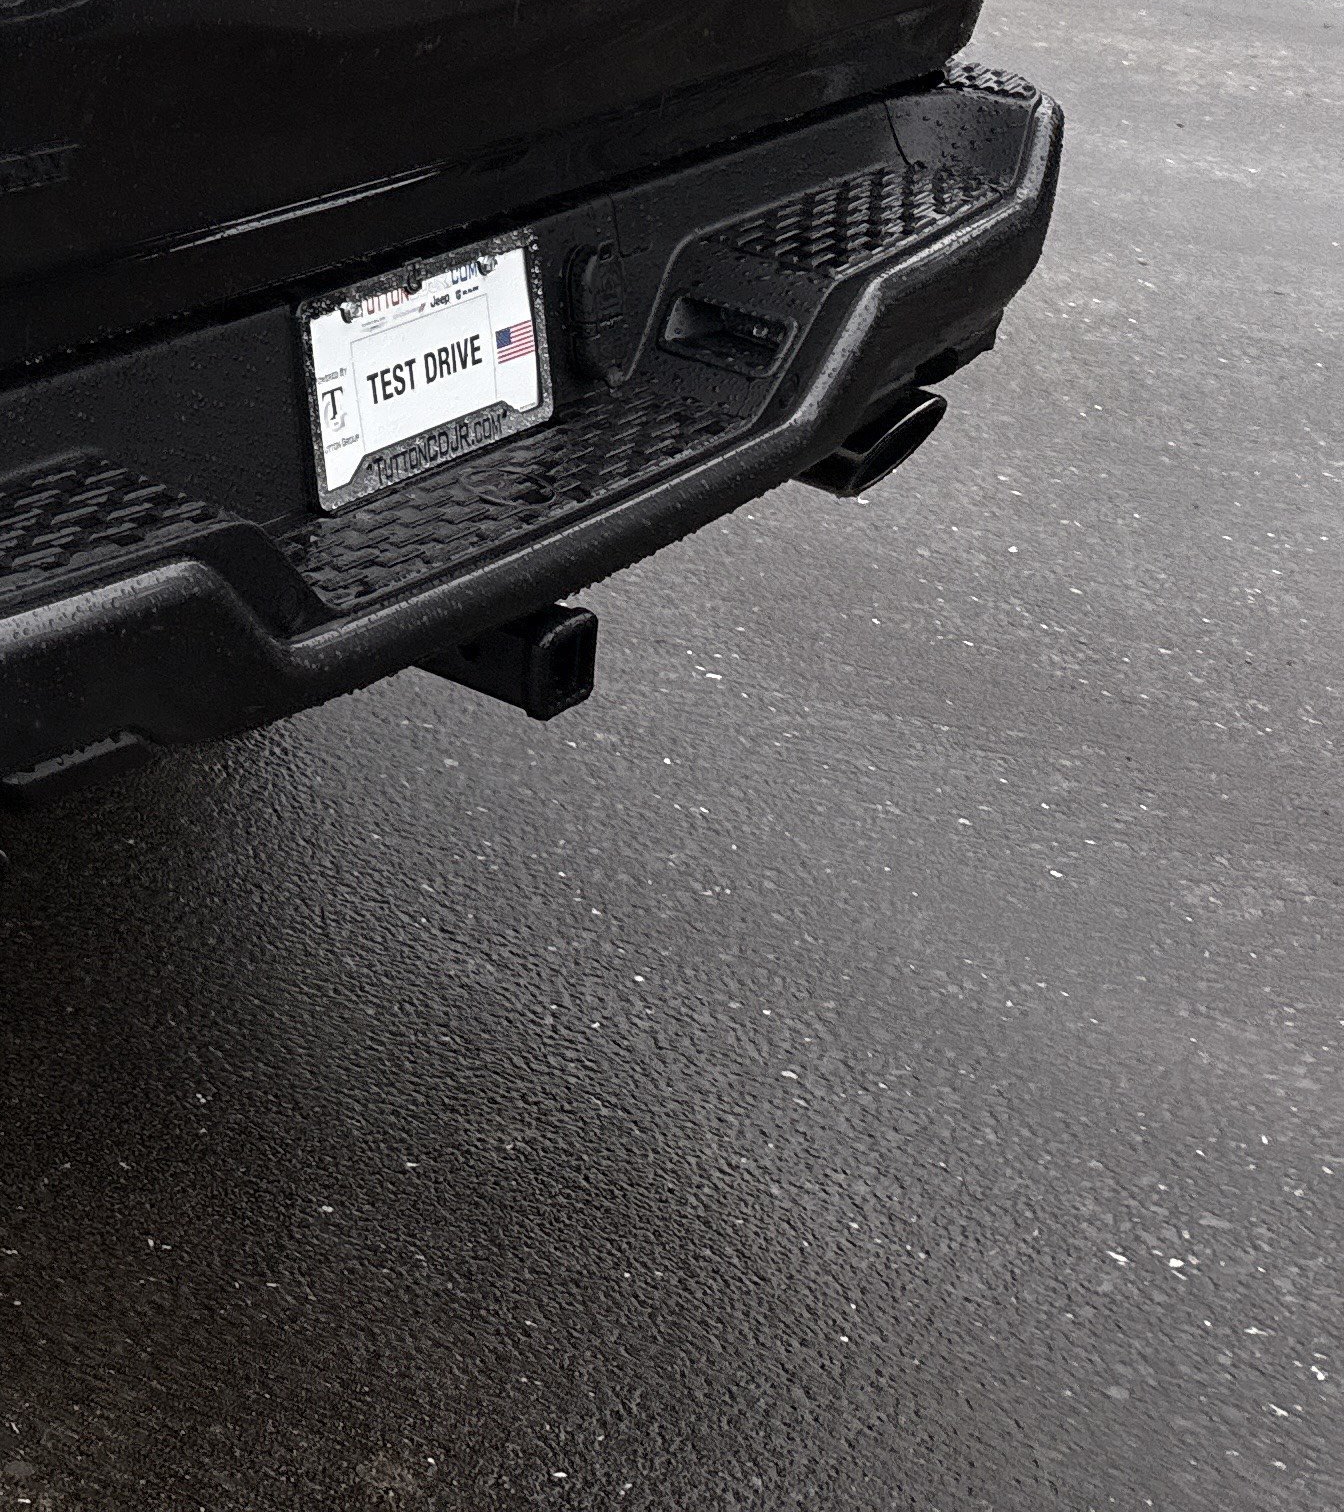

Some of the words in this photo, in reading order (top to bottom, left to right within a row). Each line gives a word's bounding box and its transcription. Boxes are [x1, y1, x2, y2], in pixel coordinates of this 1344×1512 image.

[430, 293, 450, 308] Jeep
[367, 358, 417, 405] TEST
[423, 334, 483, 385] DRIVE
